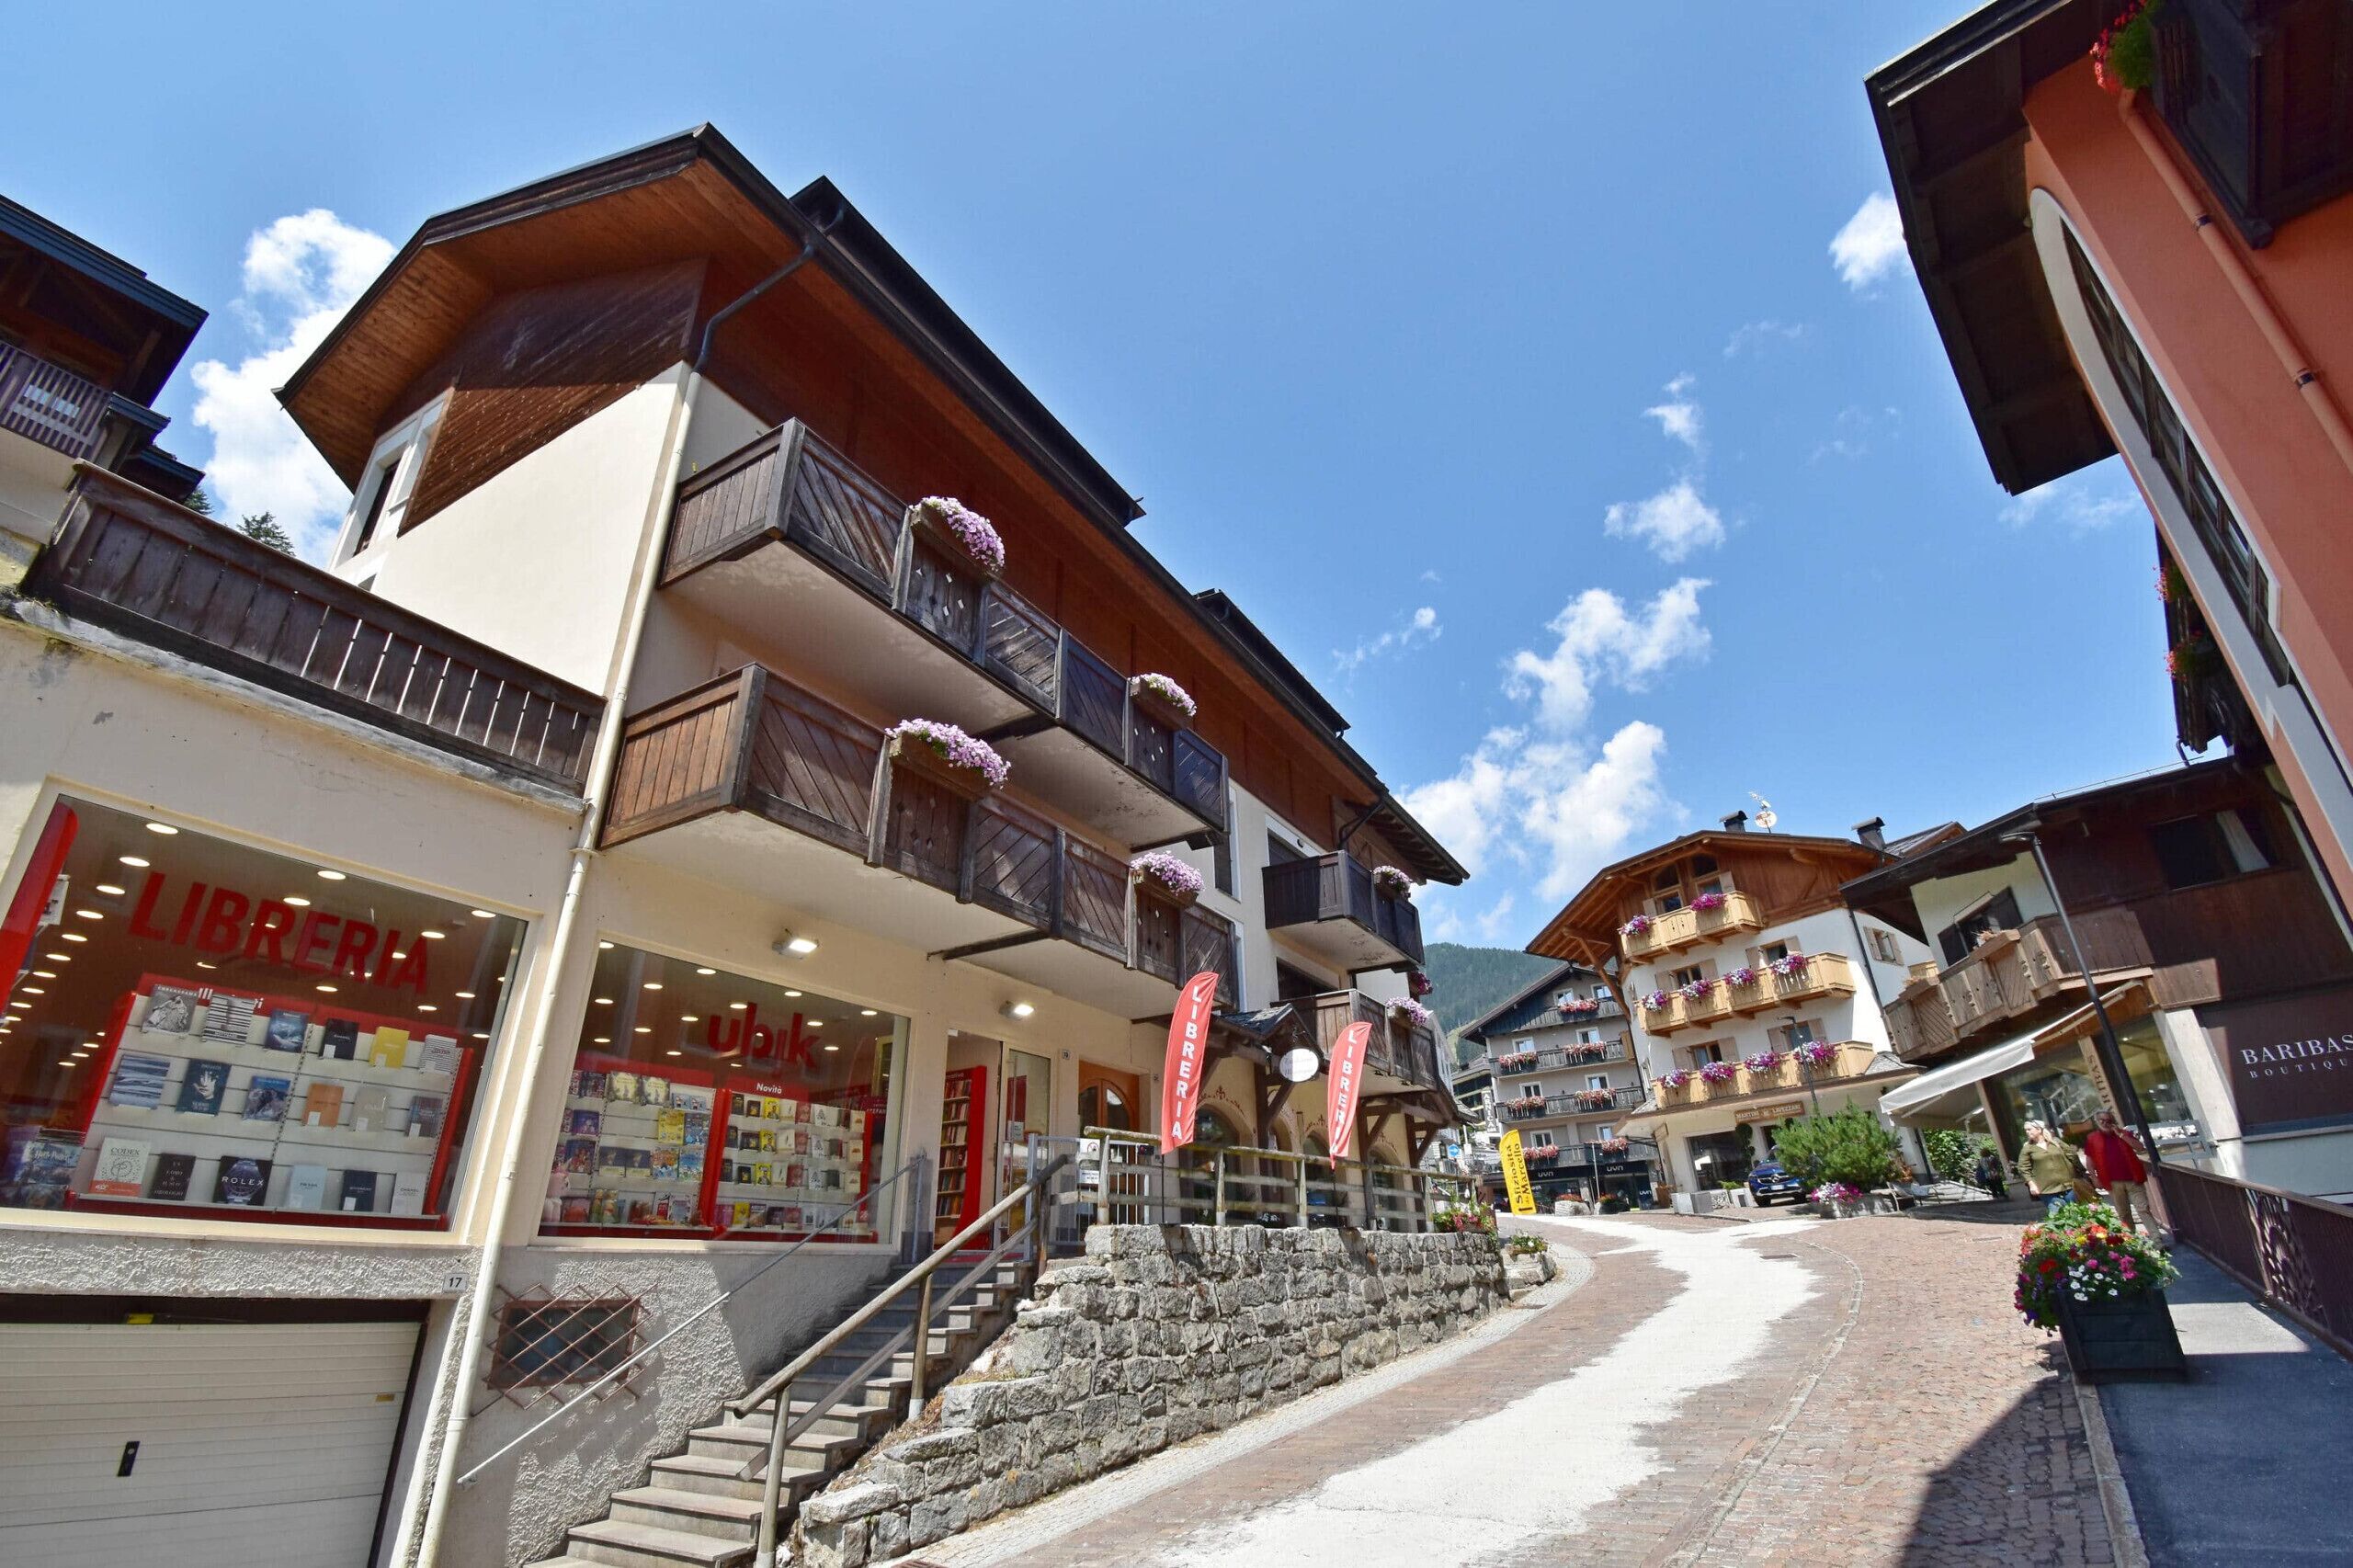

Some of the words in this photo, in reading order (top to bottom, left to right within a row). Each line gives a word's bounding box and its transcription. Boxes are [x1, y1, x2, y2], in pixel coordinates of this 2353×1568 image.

[128, 871, 428, 996] LIBRERIA
[708, 1001, 821, 1070] ubik
[2241, 1034, 2353, 1064] BARIBAS
[1172, 985, 1202, 1140] LIBRERIA
[2249, 1059, 2353, 1078] BOUTIQU
[756, 1083, 782, 1094] Novità
[110, 1147, 141, 1155] CODEX
[222, 1176, 264, 1186] ROLEX
[449, 1278, 462, 1288] 17
